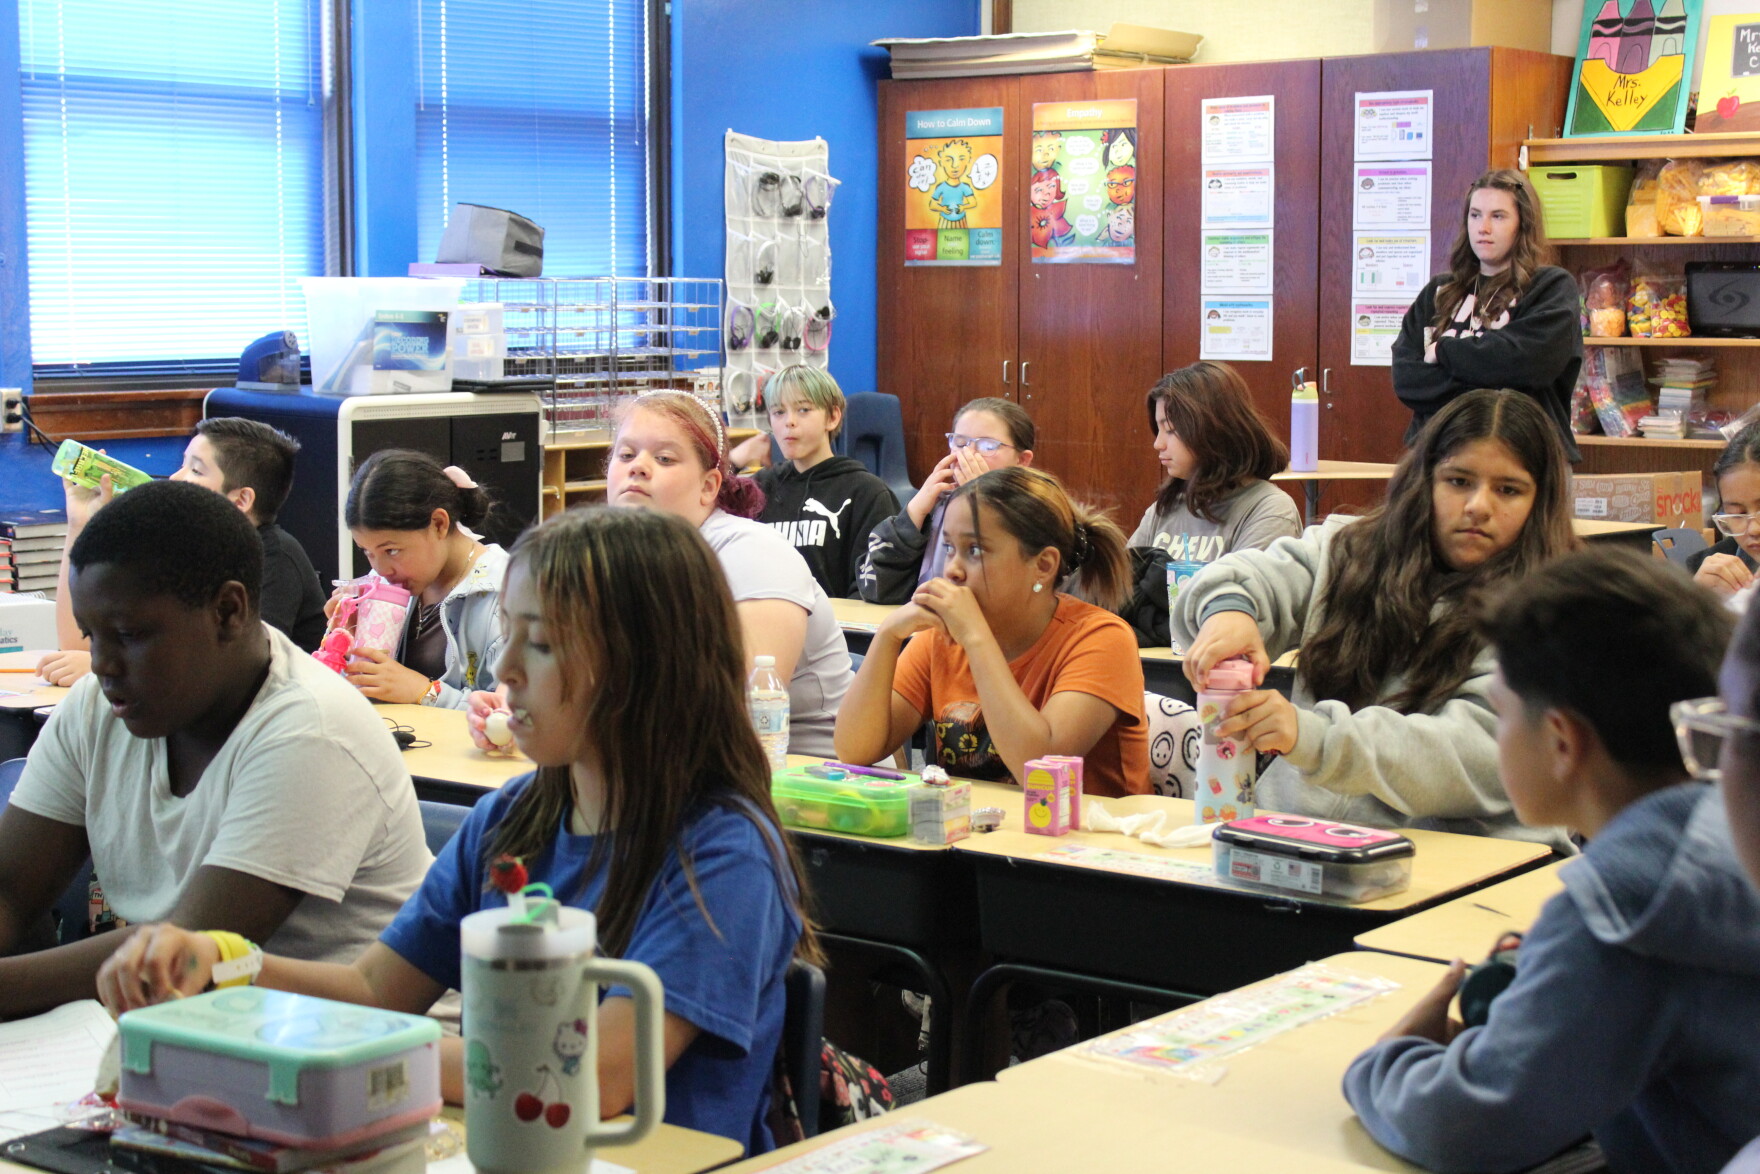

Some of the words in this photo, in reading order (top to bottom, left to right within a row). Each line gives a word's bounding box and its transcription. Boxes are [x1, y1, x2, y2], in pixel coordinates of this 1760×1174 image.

[1740, 28, 1760, 42] Mr
[1613, 75, 1641, 89] Mrs.
[1606, 90, 1648, 109] Kelley
[1066, 106, 1103, 118] Empathy
[917, 119, 935, 129] How
[937, 119, 945, 128] to
[946, 118, 966, 128] Calm
[967, 117, 992, 127] Down
[942, 247, 964, 256] feeling
[391, 343, 429, 353] POWER
[768, 520, 827, 546] UMA
